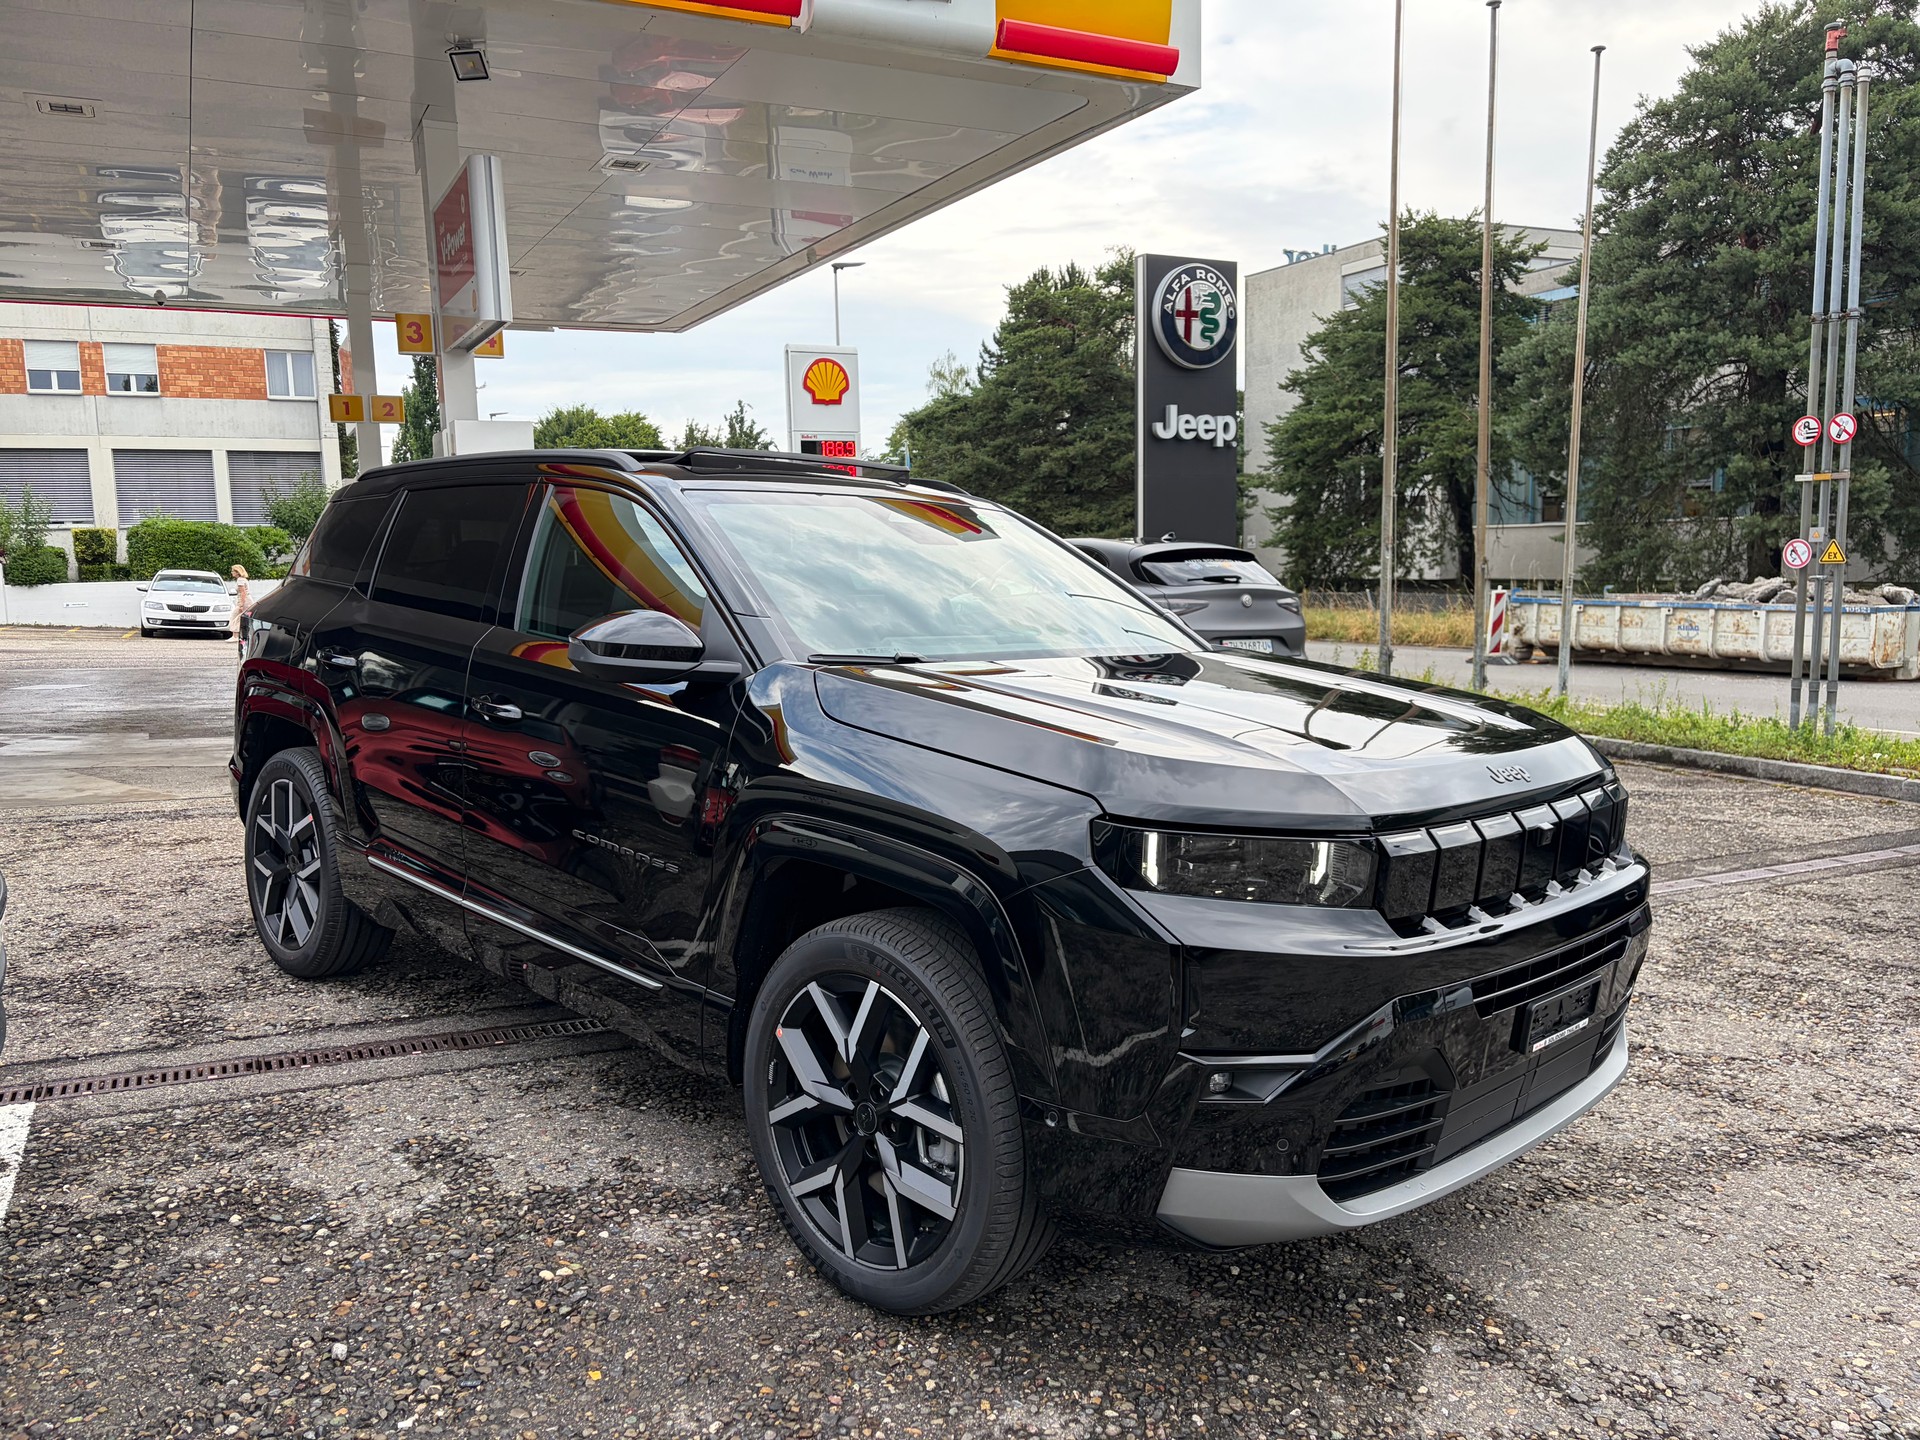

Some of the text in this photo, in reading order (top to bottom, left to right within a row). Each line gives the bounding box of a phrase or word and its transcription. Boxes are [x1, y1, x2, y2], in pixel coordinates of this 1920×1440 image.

[440, 224, 466, 265] V-Power
[1163, 269, 1236, 320] ALFA ROMEO
[406, 321, 424, 344] 3
[342, 401, 395, 417] 1 2
[1151, 404, 1237, 448] Jeep
[1827, 552, 1838, 560] EX
[1485, 765, 1531, 784] Jeep
[872, 955, 955, 1044] MICHELIN
